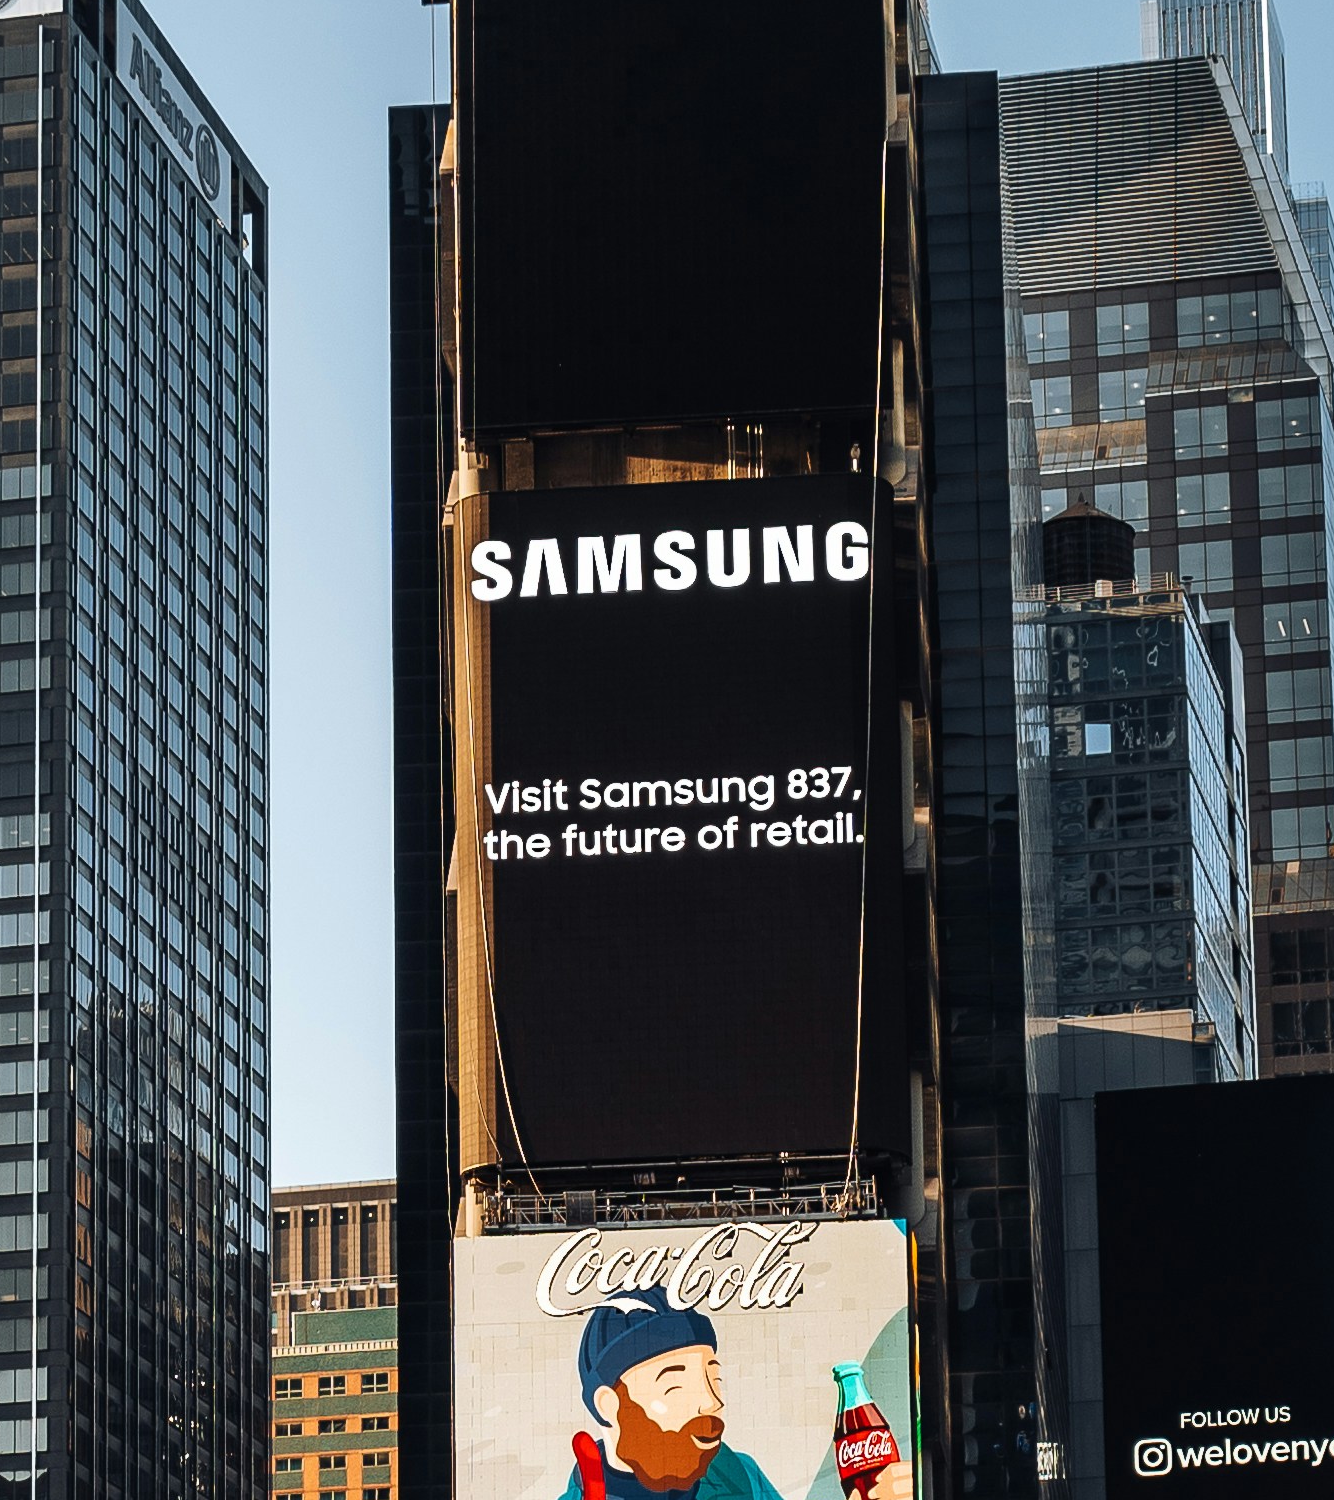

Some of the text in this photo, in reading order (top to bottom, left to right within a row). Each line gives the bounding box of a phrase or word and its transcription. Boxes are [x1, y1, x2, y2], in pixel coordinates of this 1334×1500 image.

[131, 33, 195, 161] Allianz
[470, 521, 869, 601] SAMSUNG
[484, 766, 863, 814] Visit Samsung 837,
[483, 812, 865, 861] the future of retail.
[535, 1221, 818, 1317] Coca-Cola
[1180, 1406, 1291, 1429] FOLLOW US
